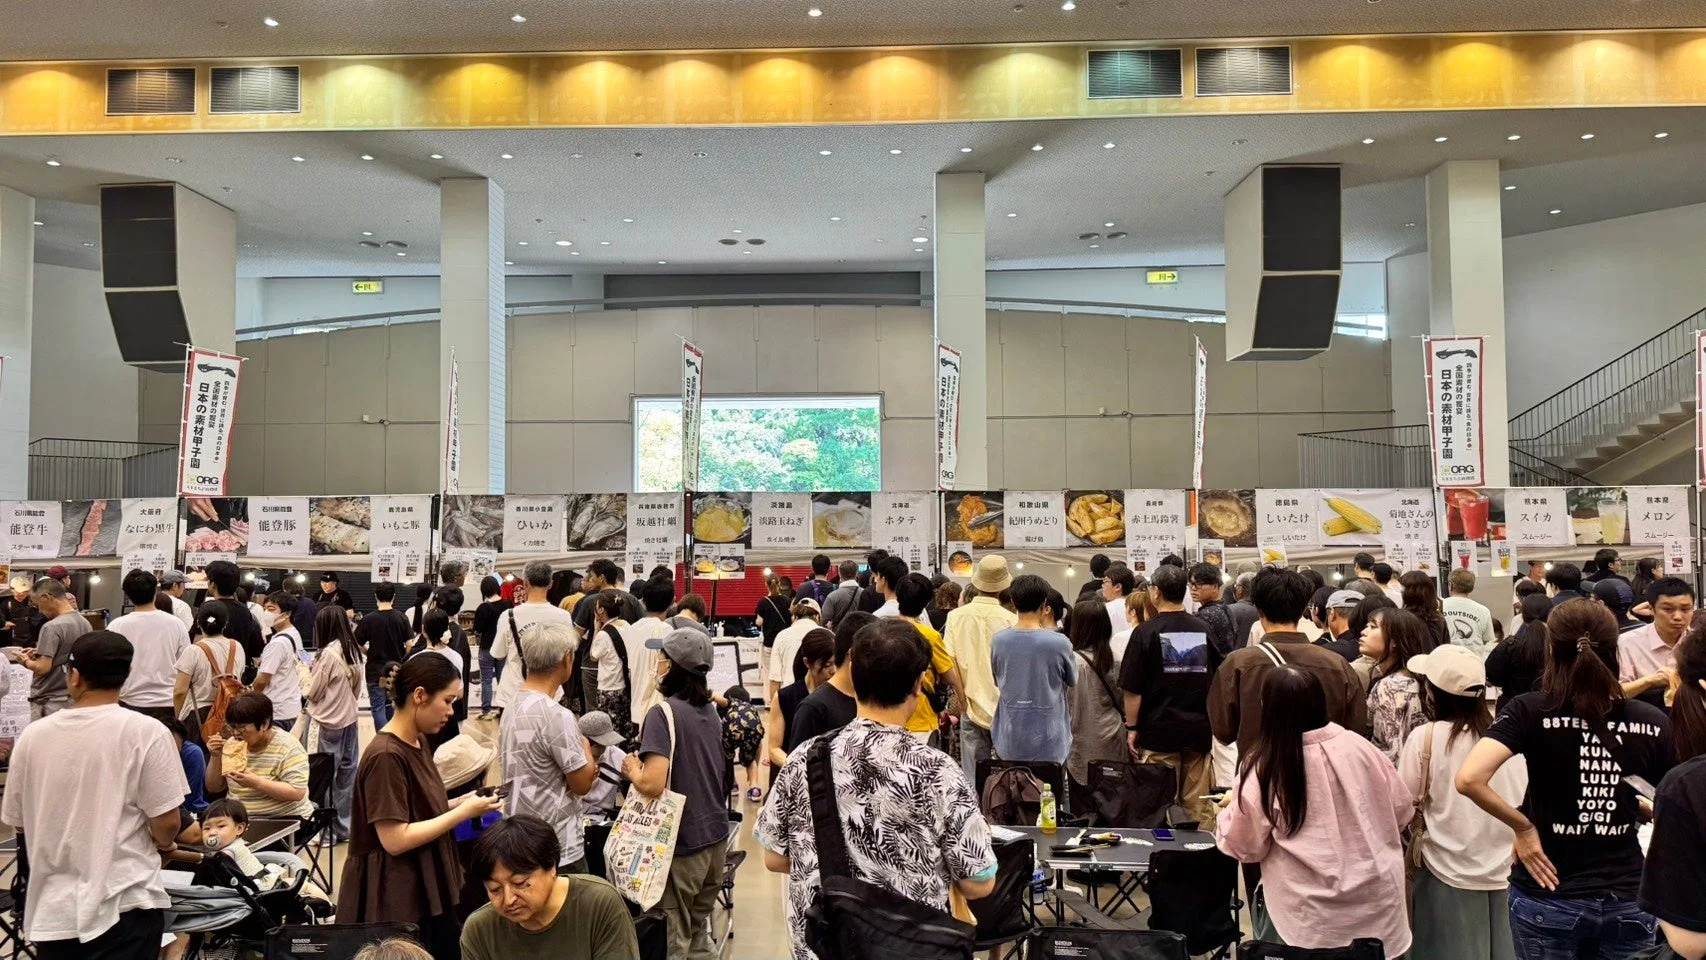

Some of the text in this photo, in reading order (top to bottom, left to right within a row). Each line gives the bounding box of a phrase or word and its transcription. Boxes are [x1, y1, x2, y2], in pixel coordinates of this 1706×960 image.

[1441, 369, 1453, 459] 日本の素材甲子園
[190, 382, 210, 469] 日本の素材甲子園
[1451, 464, 1475, 474] ORG
[196, 475, 219, 485] ORG
[758, 516, 804, 526] 淡路玉ねぎ
[885, 515, 917, 525] ホタテ
[1008, 515, 1058, 526] 紀州うめどり
[1266, 513, 1310, 524] しいたけ
[1520, 511, 1552, 523] スイカ
[1642, 512, 1676, 522] メロン
[10, 522, 49, 536] 能登牛
[125, 522, 174, 534] なにわ黒牛
[258, 519, 297, 531] 能登豚
[382, 520, 421, 531] いもこ豚
[516, 519, 553, 531] ひいか
[1395, 519, 1431, 529] とうきび
[1448, 610, 1481, 623] OUTSIDE!
[1542, 717, 1661, 737] 88TEE FAMILY
[1579, 758, 1622, 772] NANA
[1580, 772, 1620, 785] LULU
[1582, 786, 1615, 798] KIKI
[1576, 799, 1617, 811] YOYO
[1552, 823, 1630, 836] WAIT WAIT
